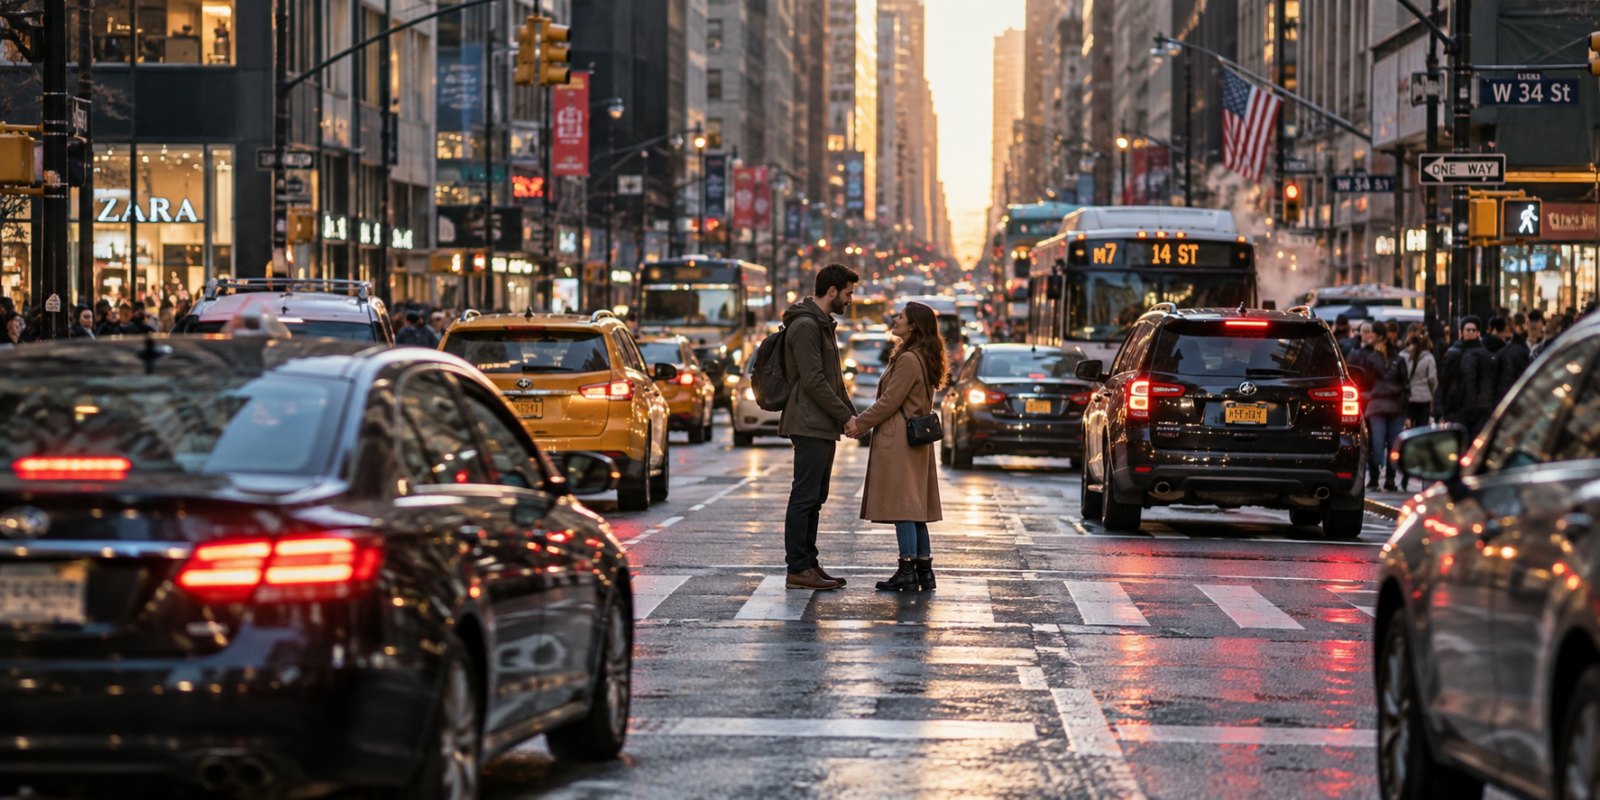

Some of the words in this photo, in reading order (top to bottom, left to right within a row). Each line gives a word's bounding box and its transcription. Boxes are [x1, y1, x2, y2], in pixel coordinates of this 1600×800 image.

[1492, 82, 1512, 103] W
[1518, 82, 1544, 103] 34
[1550, 82, 1571, 103] St
[1432, 163, 1456, 175] ONE
[1467, 163, 1494, 175] WAY
[97, 197, 198, 222] ZARA
[1093, 242, 1117, 264] M7
[1152, 243, 1172, 264] 14
[1178, 244, 1199, 264] ST
